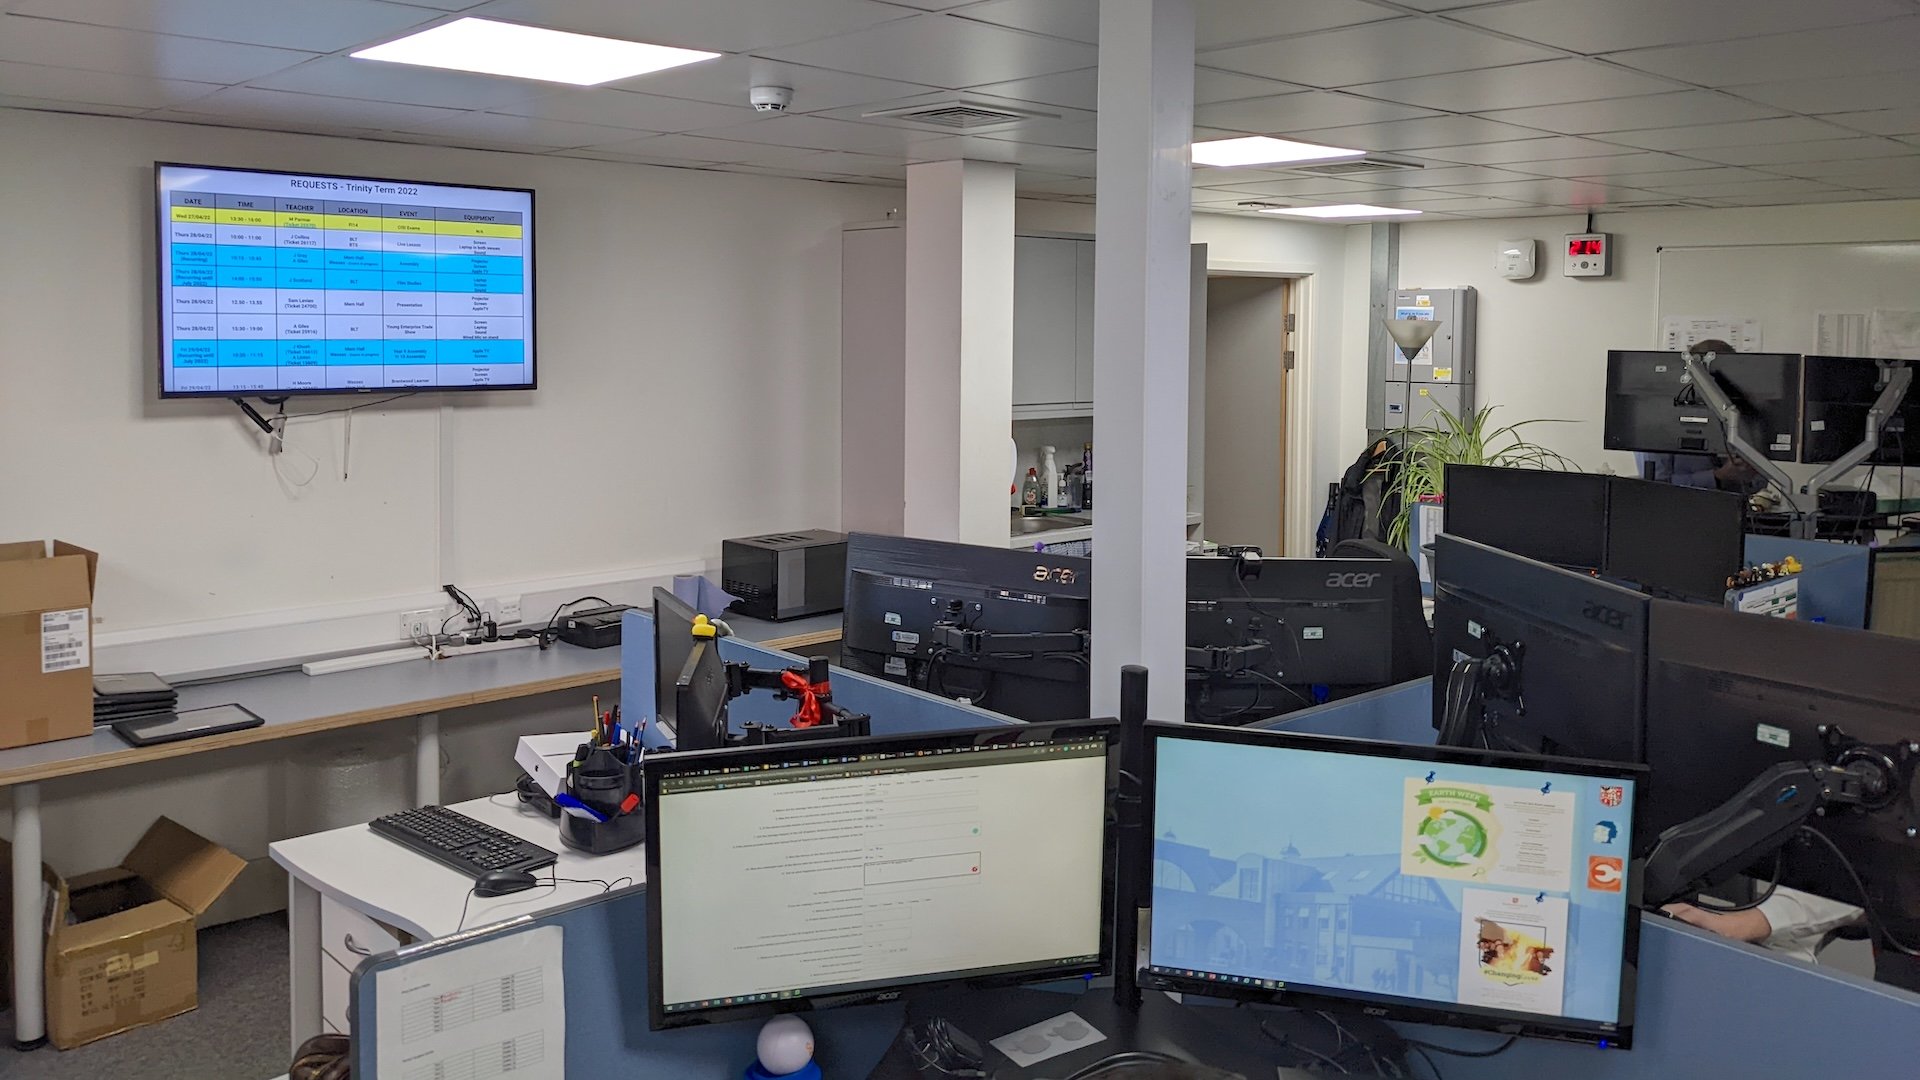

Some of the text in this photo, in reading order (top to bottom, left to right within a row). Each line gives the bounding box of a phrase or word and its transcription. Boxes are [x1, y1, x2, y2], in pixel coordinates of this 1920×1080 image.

[290, 180, 338, 190] REQUESTS
[346, 184, 372, 194] Trinity
[375, 186, 396, 194] Term
[398, 187, 418, 195] 2022
[1326, 573, 1381, 588] acer
[1457, 791, 1480, 800] WEEK
[877, 990, 900, 1000] acer
[1364, 1008, 1389, 1016] acer
